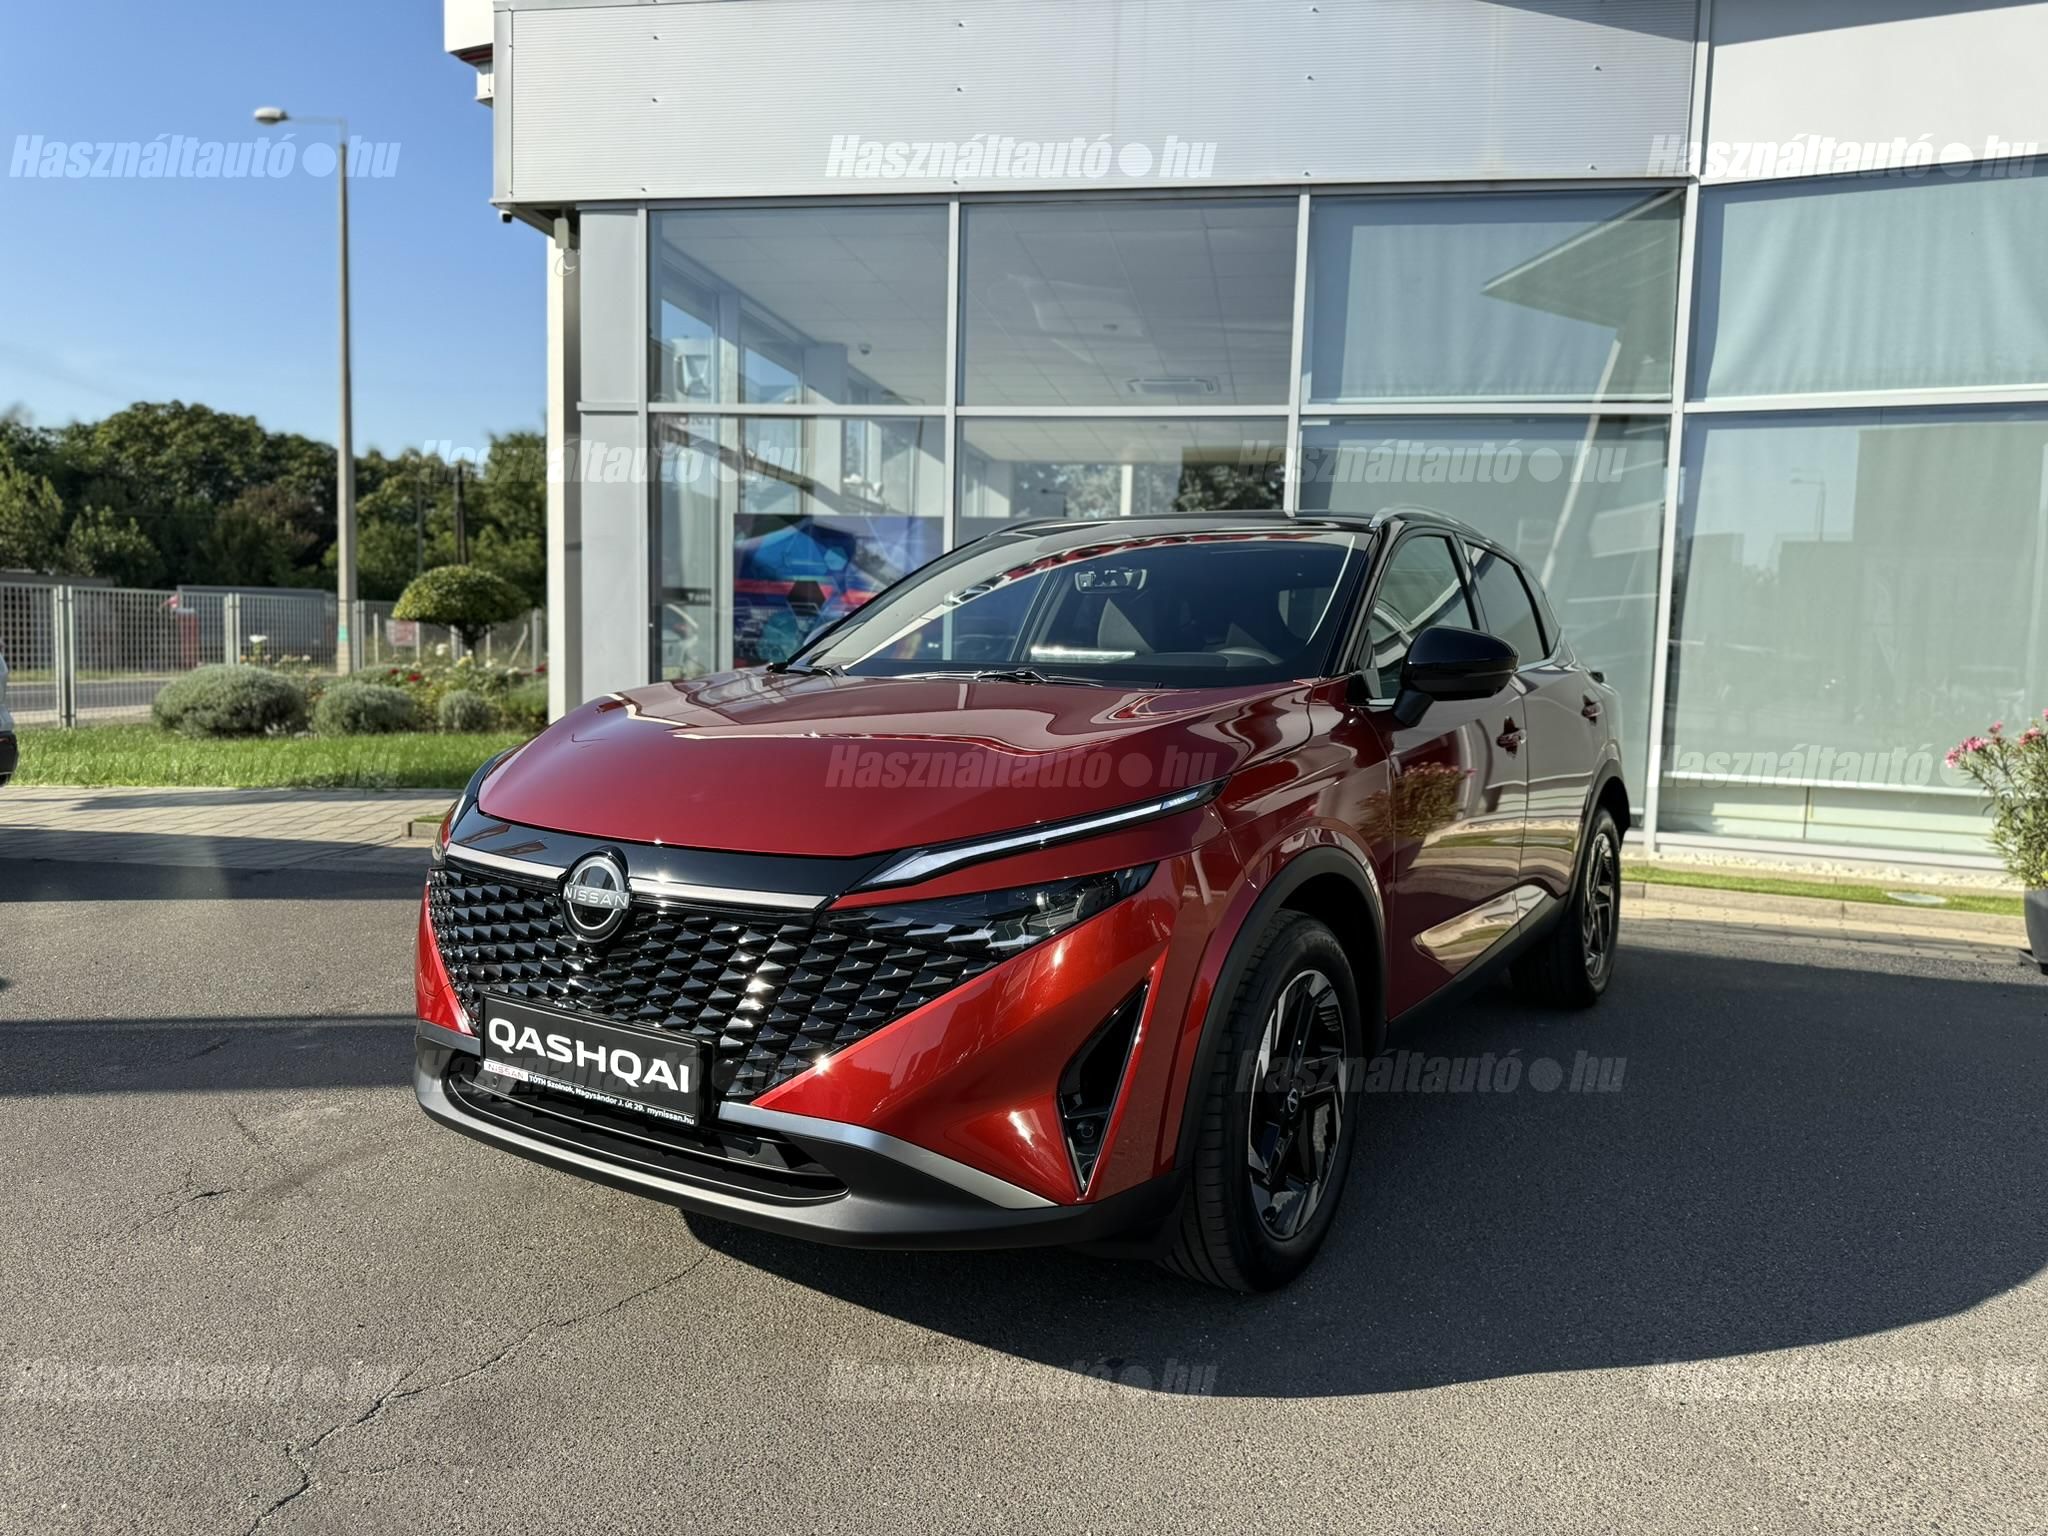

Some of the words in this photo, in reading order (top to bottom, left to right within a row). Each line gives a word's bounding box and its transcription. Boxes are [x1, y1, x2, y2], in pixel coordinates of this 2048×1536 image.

[564, 886, 627, 907] NISSAN
[488, 1017, 689, 1093] QASHQAI
[488, 1064, 524, 1079] NISSAN
[647, 1107, 694, 1125] mynissan.hu
